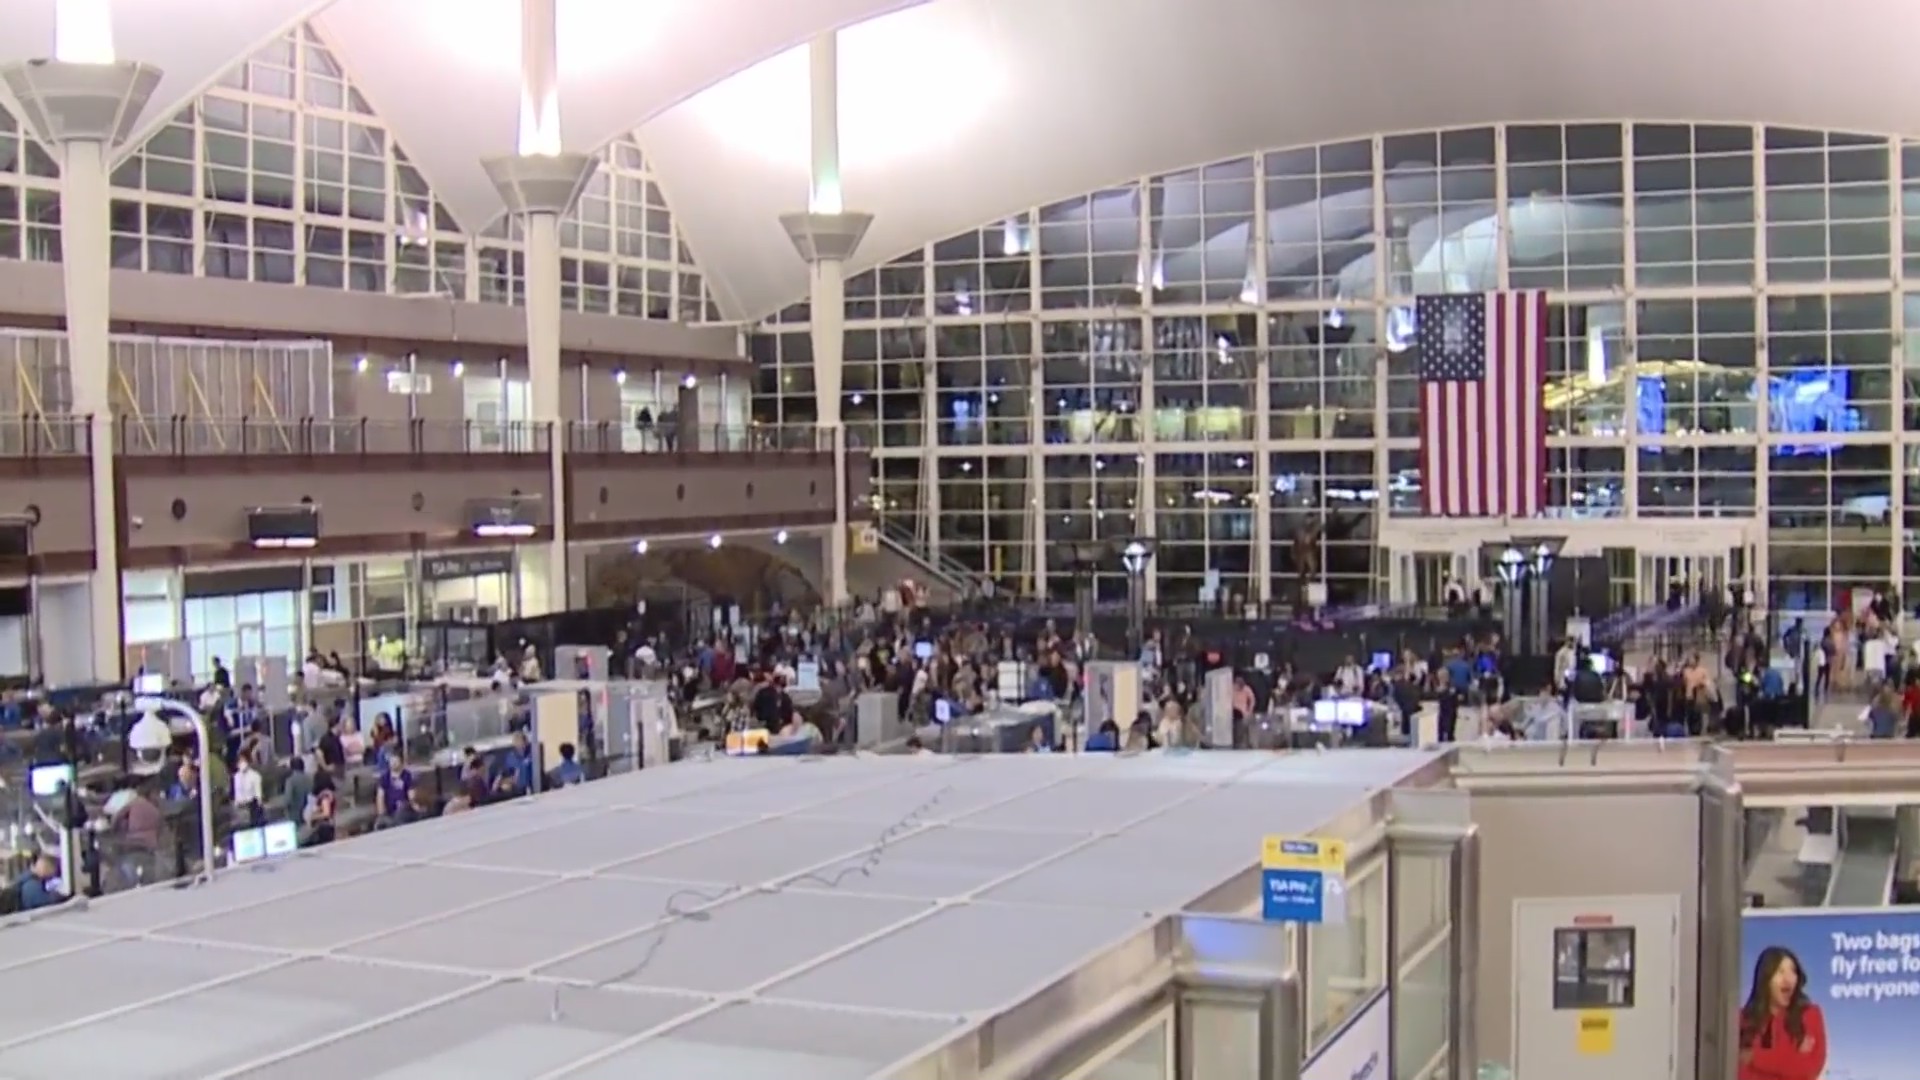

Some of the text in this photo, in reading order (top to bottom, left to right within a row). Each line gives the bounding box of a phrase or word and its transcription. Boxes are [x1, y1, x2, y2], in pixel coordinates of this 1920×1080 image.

[1831, 930, 1920, 954] Two bags
[1831, 954, 1920, 980] fly free fo
[1830, 981, 1920, 1002] everyone
